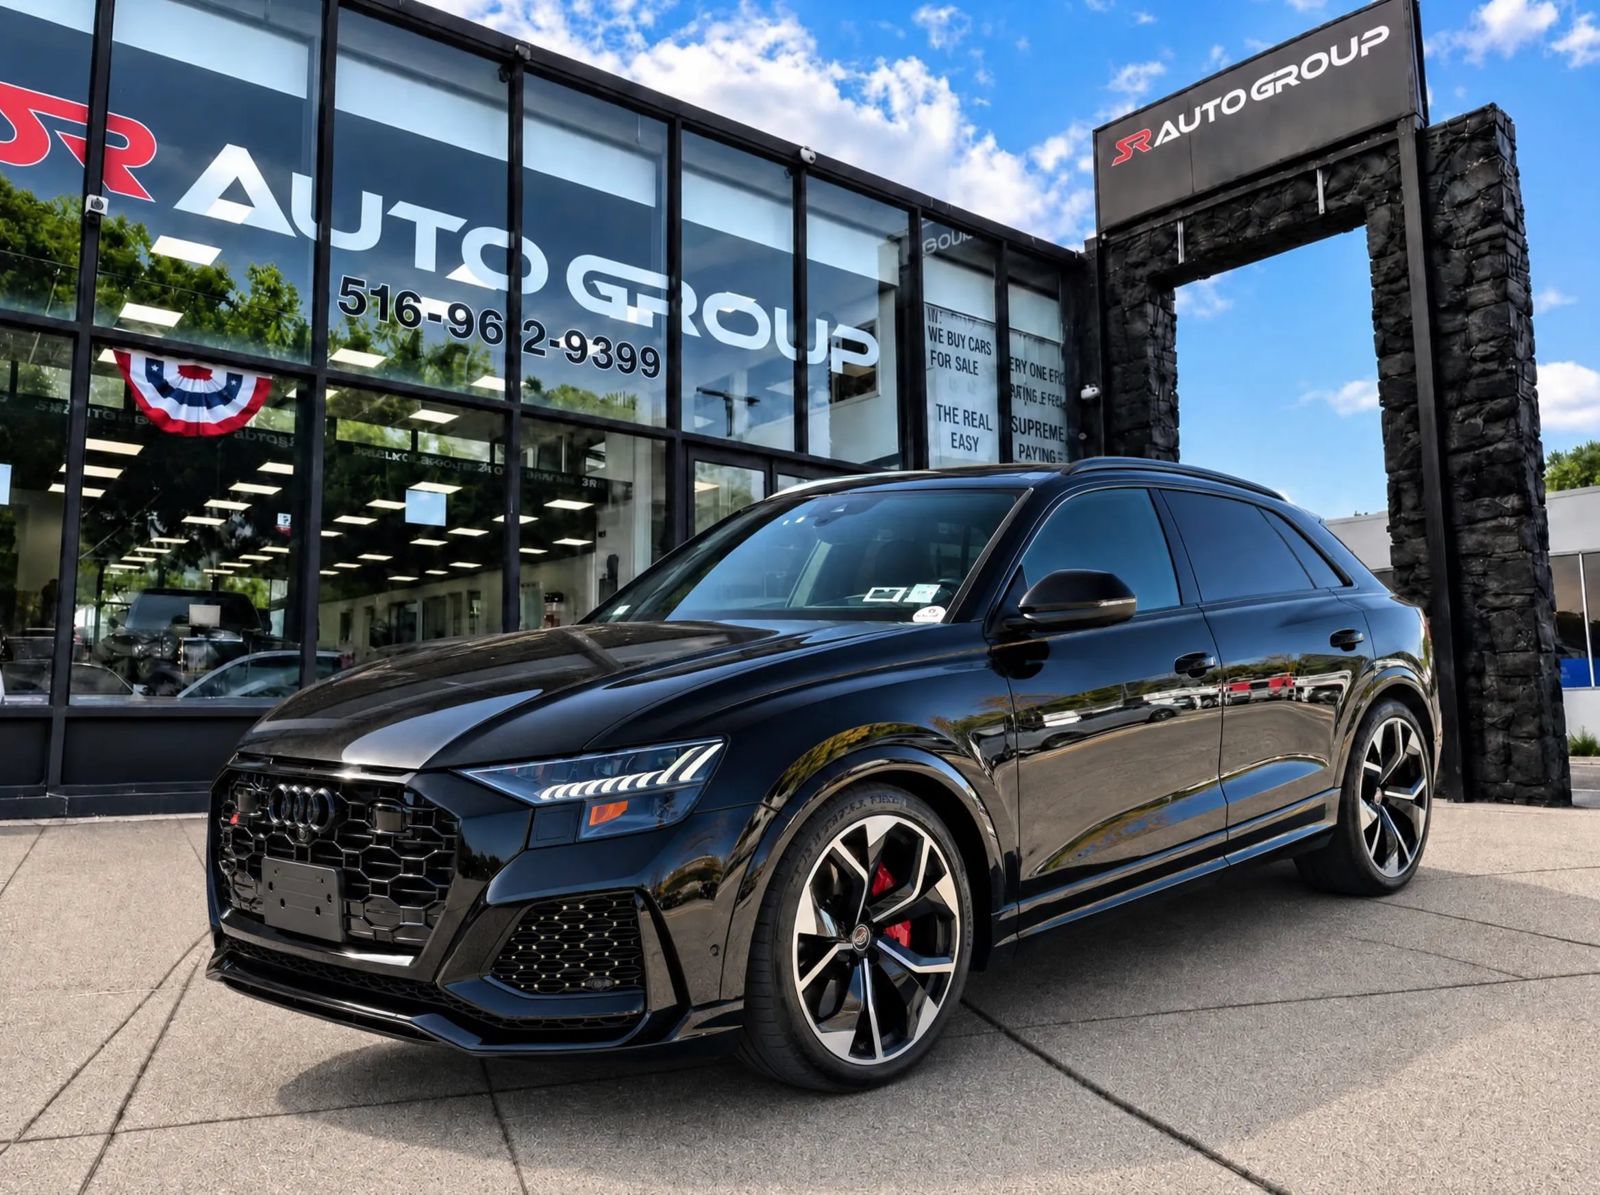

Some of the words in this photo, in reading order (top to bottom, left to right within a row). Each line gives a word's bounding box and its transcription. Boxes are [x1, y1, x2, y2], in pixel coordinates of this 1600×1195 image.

[1111, 128, 1153, 167] SR
[1153, 88, 1247, 148] AUTO
[1250, 25, 1390, 101] GROUP
[173, 143, 549, 295] AUTO
[566, 254, 880, 374] GROUP
[336, 275, 661, 380] 516-962-9399
[928, 325, 944, 344] WE
[947, 330, 966, 349] BUY
[968, 336, 992, 356] CARS
[930, 349, 952, 369] FOR
[955, 356, 979, 376] SALE
[1029, 362, 1048, 381] ONE
[936, 403, 960, 425] THE
[963, 409, 993, 432] REAL
[1010, 415, 1065, 442] SUPREME
[951, 431, 979, 453] EASY
[1018, 443, 1056, 463] PAYING
